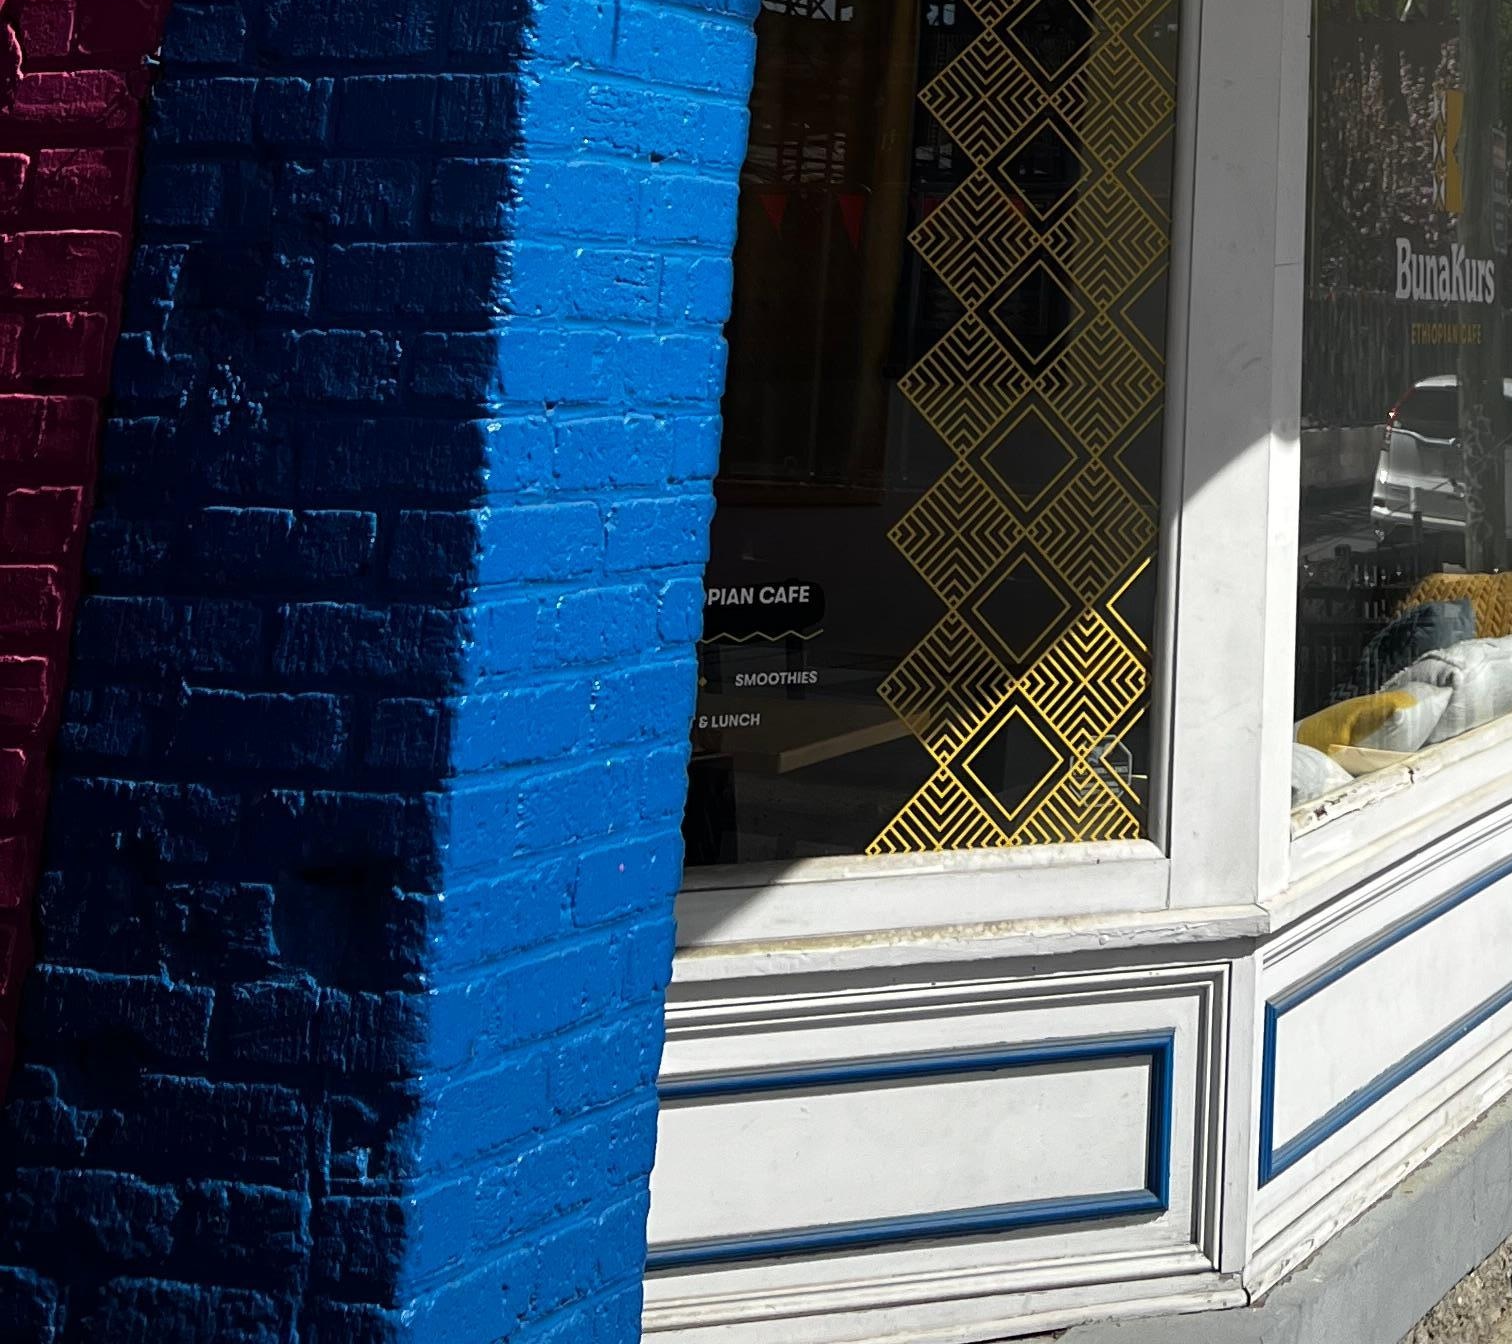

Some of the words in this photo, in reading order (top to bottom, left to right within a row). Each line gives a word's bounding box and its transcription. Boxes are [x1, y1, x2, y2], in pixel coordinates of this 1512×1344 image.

[1395, 237, 1495, 304] BunaKurs
[1411, 323, 1458, 344] ETHIOPIAN
[1461, 323, 1481, 344] CAFE
[759, 586, 810, 604] CAFE
[736, 671, 818, 687] SMOOTHIES
[698, 715, 709, 729] &
[711, 713, 761, 728] LUNCH
